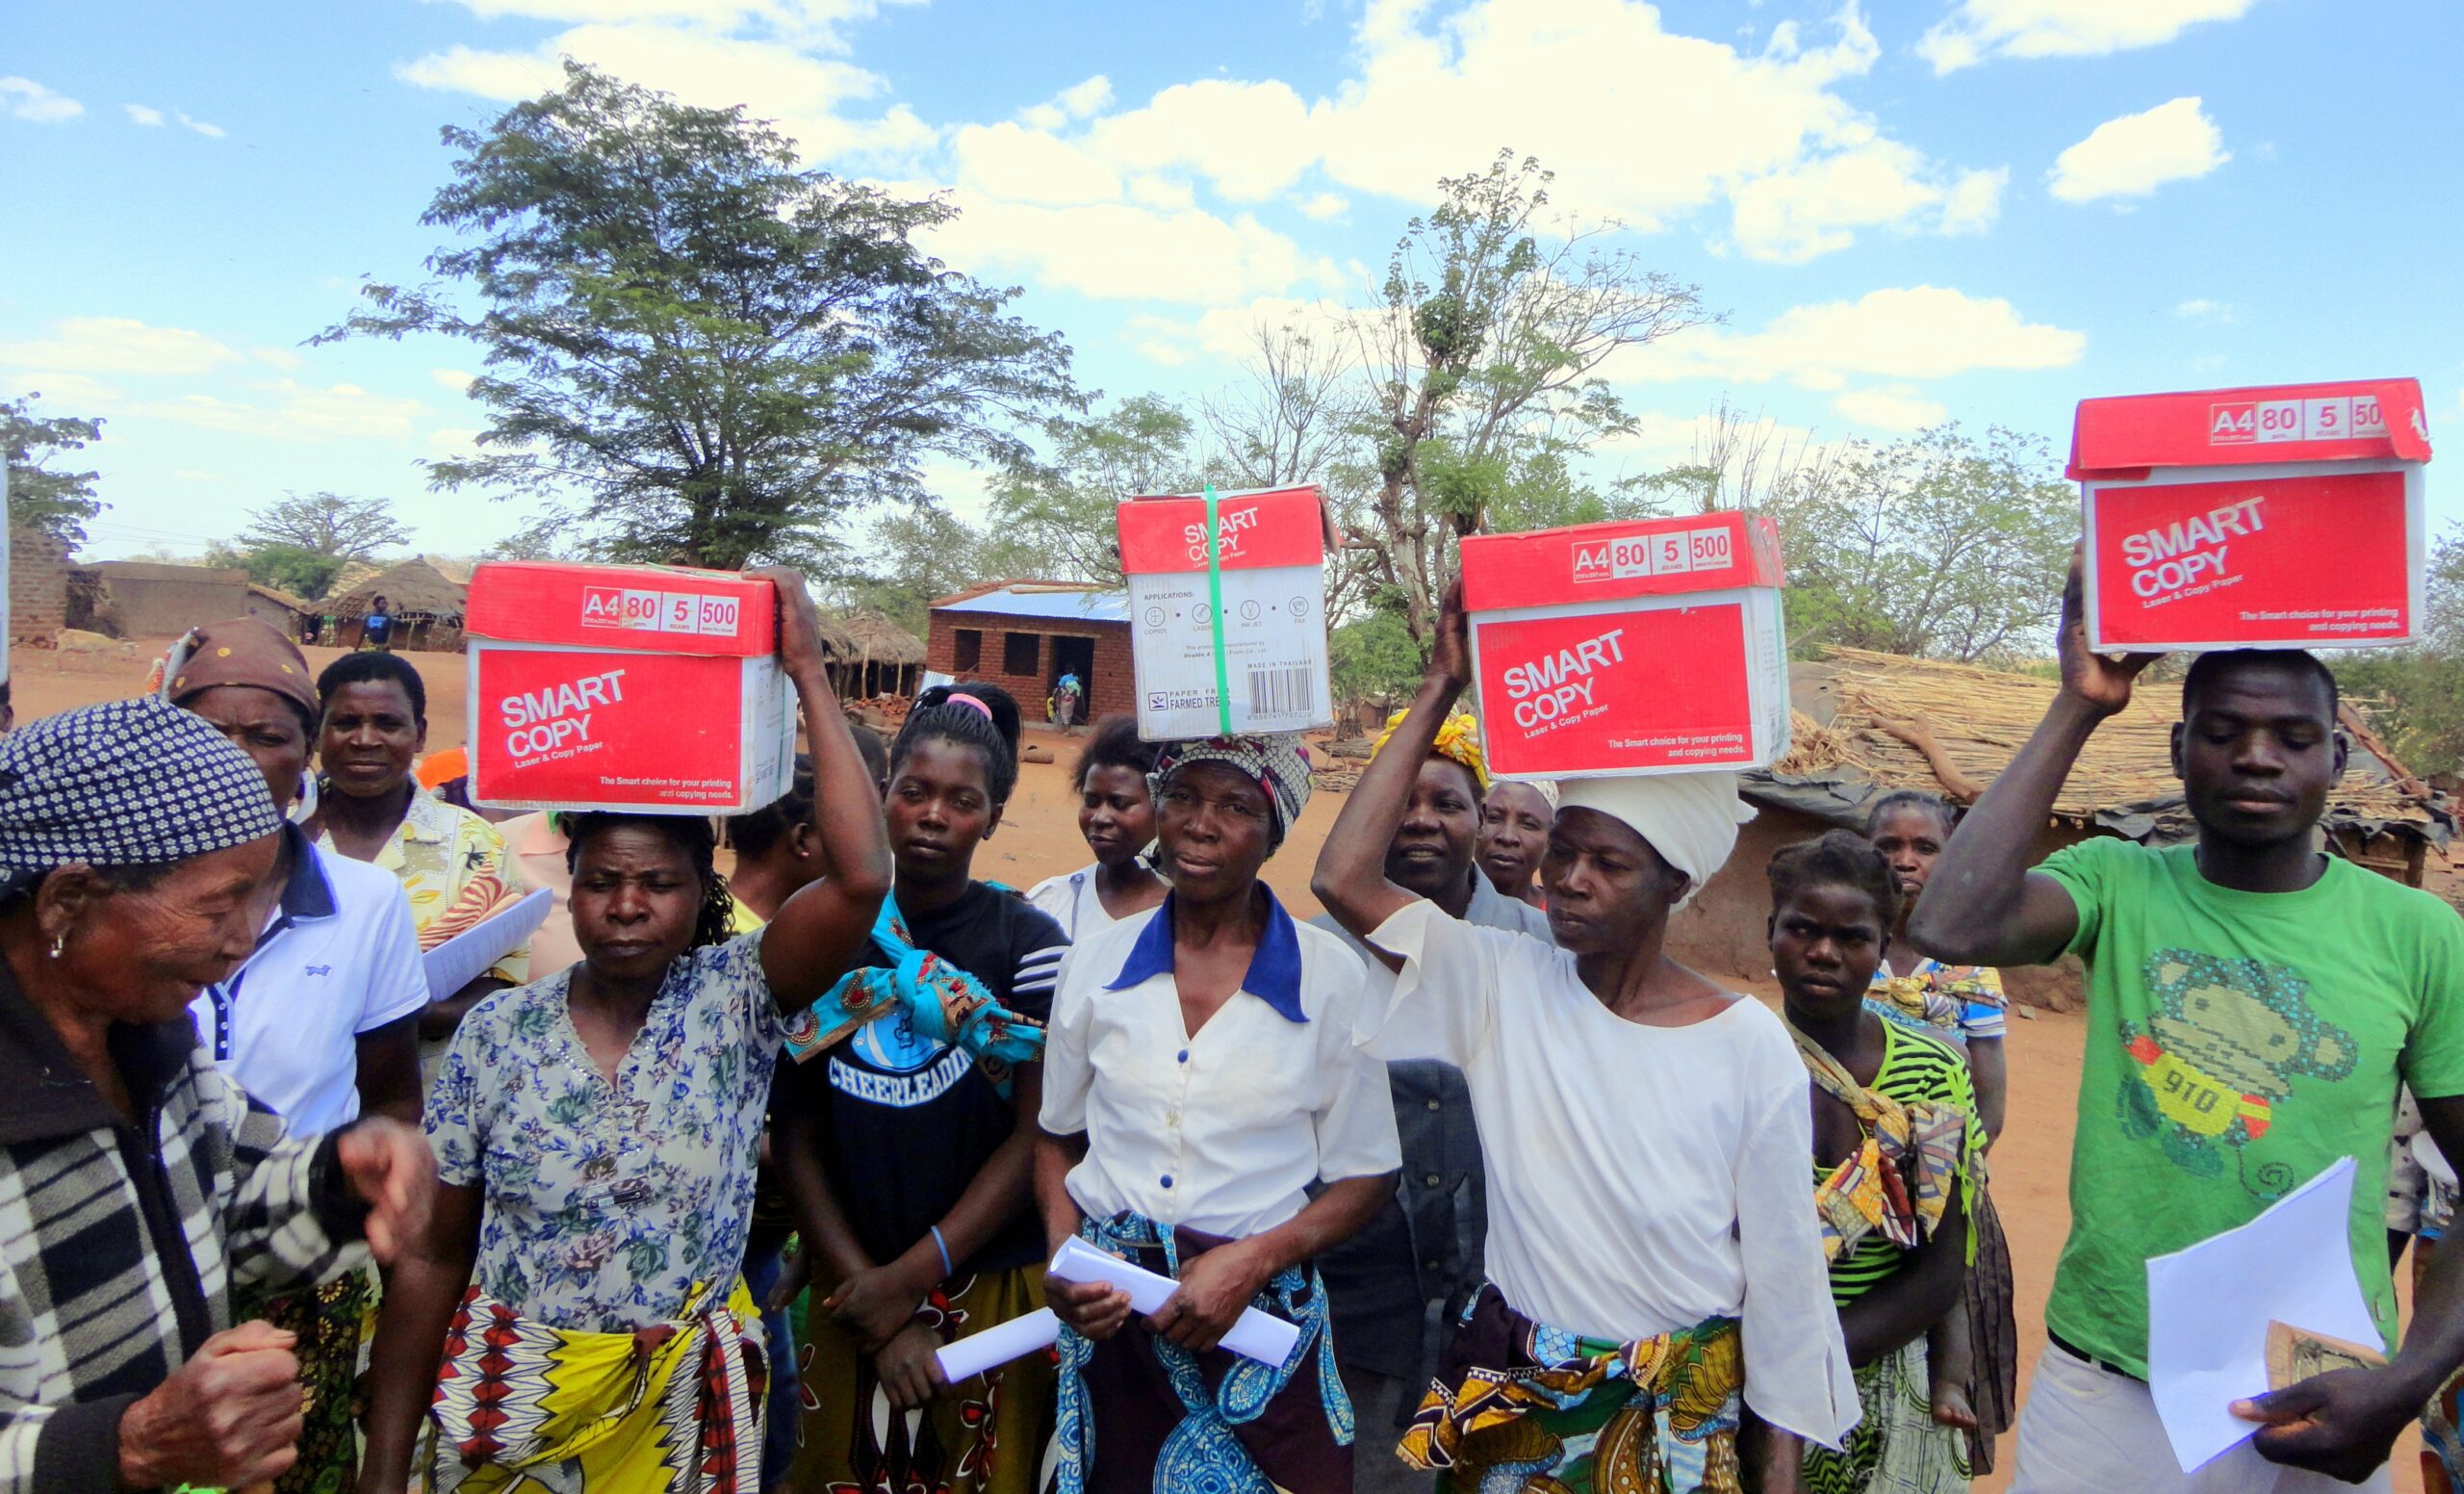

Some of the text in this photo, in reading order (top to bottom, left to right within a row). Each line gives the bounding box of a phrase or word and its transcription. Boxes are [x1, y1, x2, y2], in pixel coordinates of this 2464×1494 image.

[2214, 409, 2254, 433] A4
[2262, 407, 2297, 430] 80
[2320, 404, 2336, 427] 5
[2122, 496, 2264, 567] SMART
[1576, 534, 1728, 571] A4 80 5 500
[2132, 545, 2228, 597] COPY
[1143, 591, 1195, 601] APPLICATIONS:
[2143, 595, 2172, 608] Laser
[2184, 583, 2210, 597] Copy
[2212, 574, 2244, 589] Paper
[584, 594, 736, 625] A4 80 5 500
[2240, 607, 2399, 620] The Smart choice for your printing
[2308, 622, 2327, 631] and
[2329, 621, 2367, 631] copying
[1503, 629, 1624, 699] SMART
[501, 668, 626, 728] SMART
[1169, 698, 1203, 710] FARMED
[1514, 677, 1594, 728] COPY
[507, 713, 592, 758] COPY
[1524, 726, 1549, 739] Laser
[1558, 714, 1581, 727] Copy
[1582, 704, 1609, 718] Paper
[514, 757, 541, 768] Laser
[552, 749, 575, 760] Copy
[576, 741, 603, 753] Paper
[1607, 733, 1743, 748] The Smart choice for your printing
[1668, 748, 1683, 757] and
[1685, 747, 1717, 758] copying
[601, 776, 615, 785] The
[616, 777, 641, 786] Smart
[681, 780, 701, 788] your
[701, 779, 732, 788] printing
[676, 790, 706, 800] copying
[2163, 1069, 2220, 1114] 910
